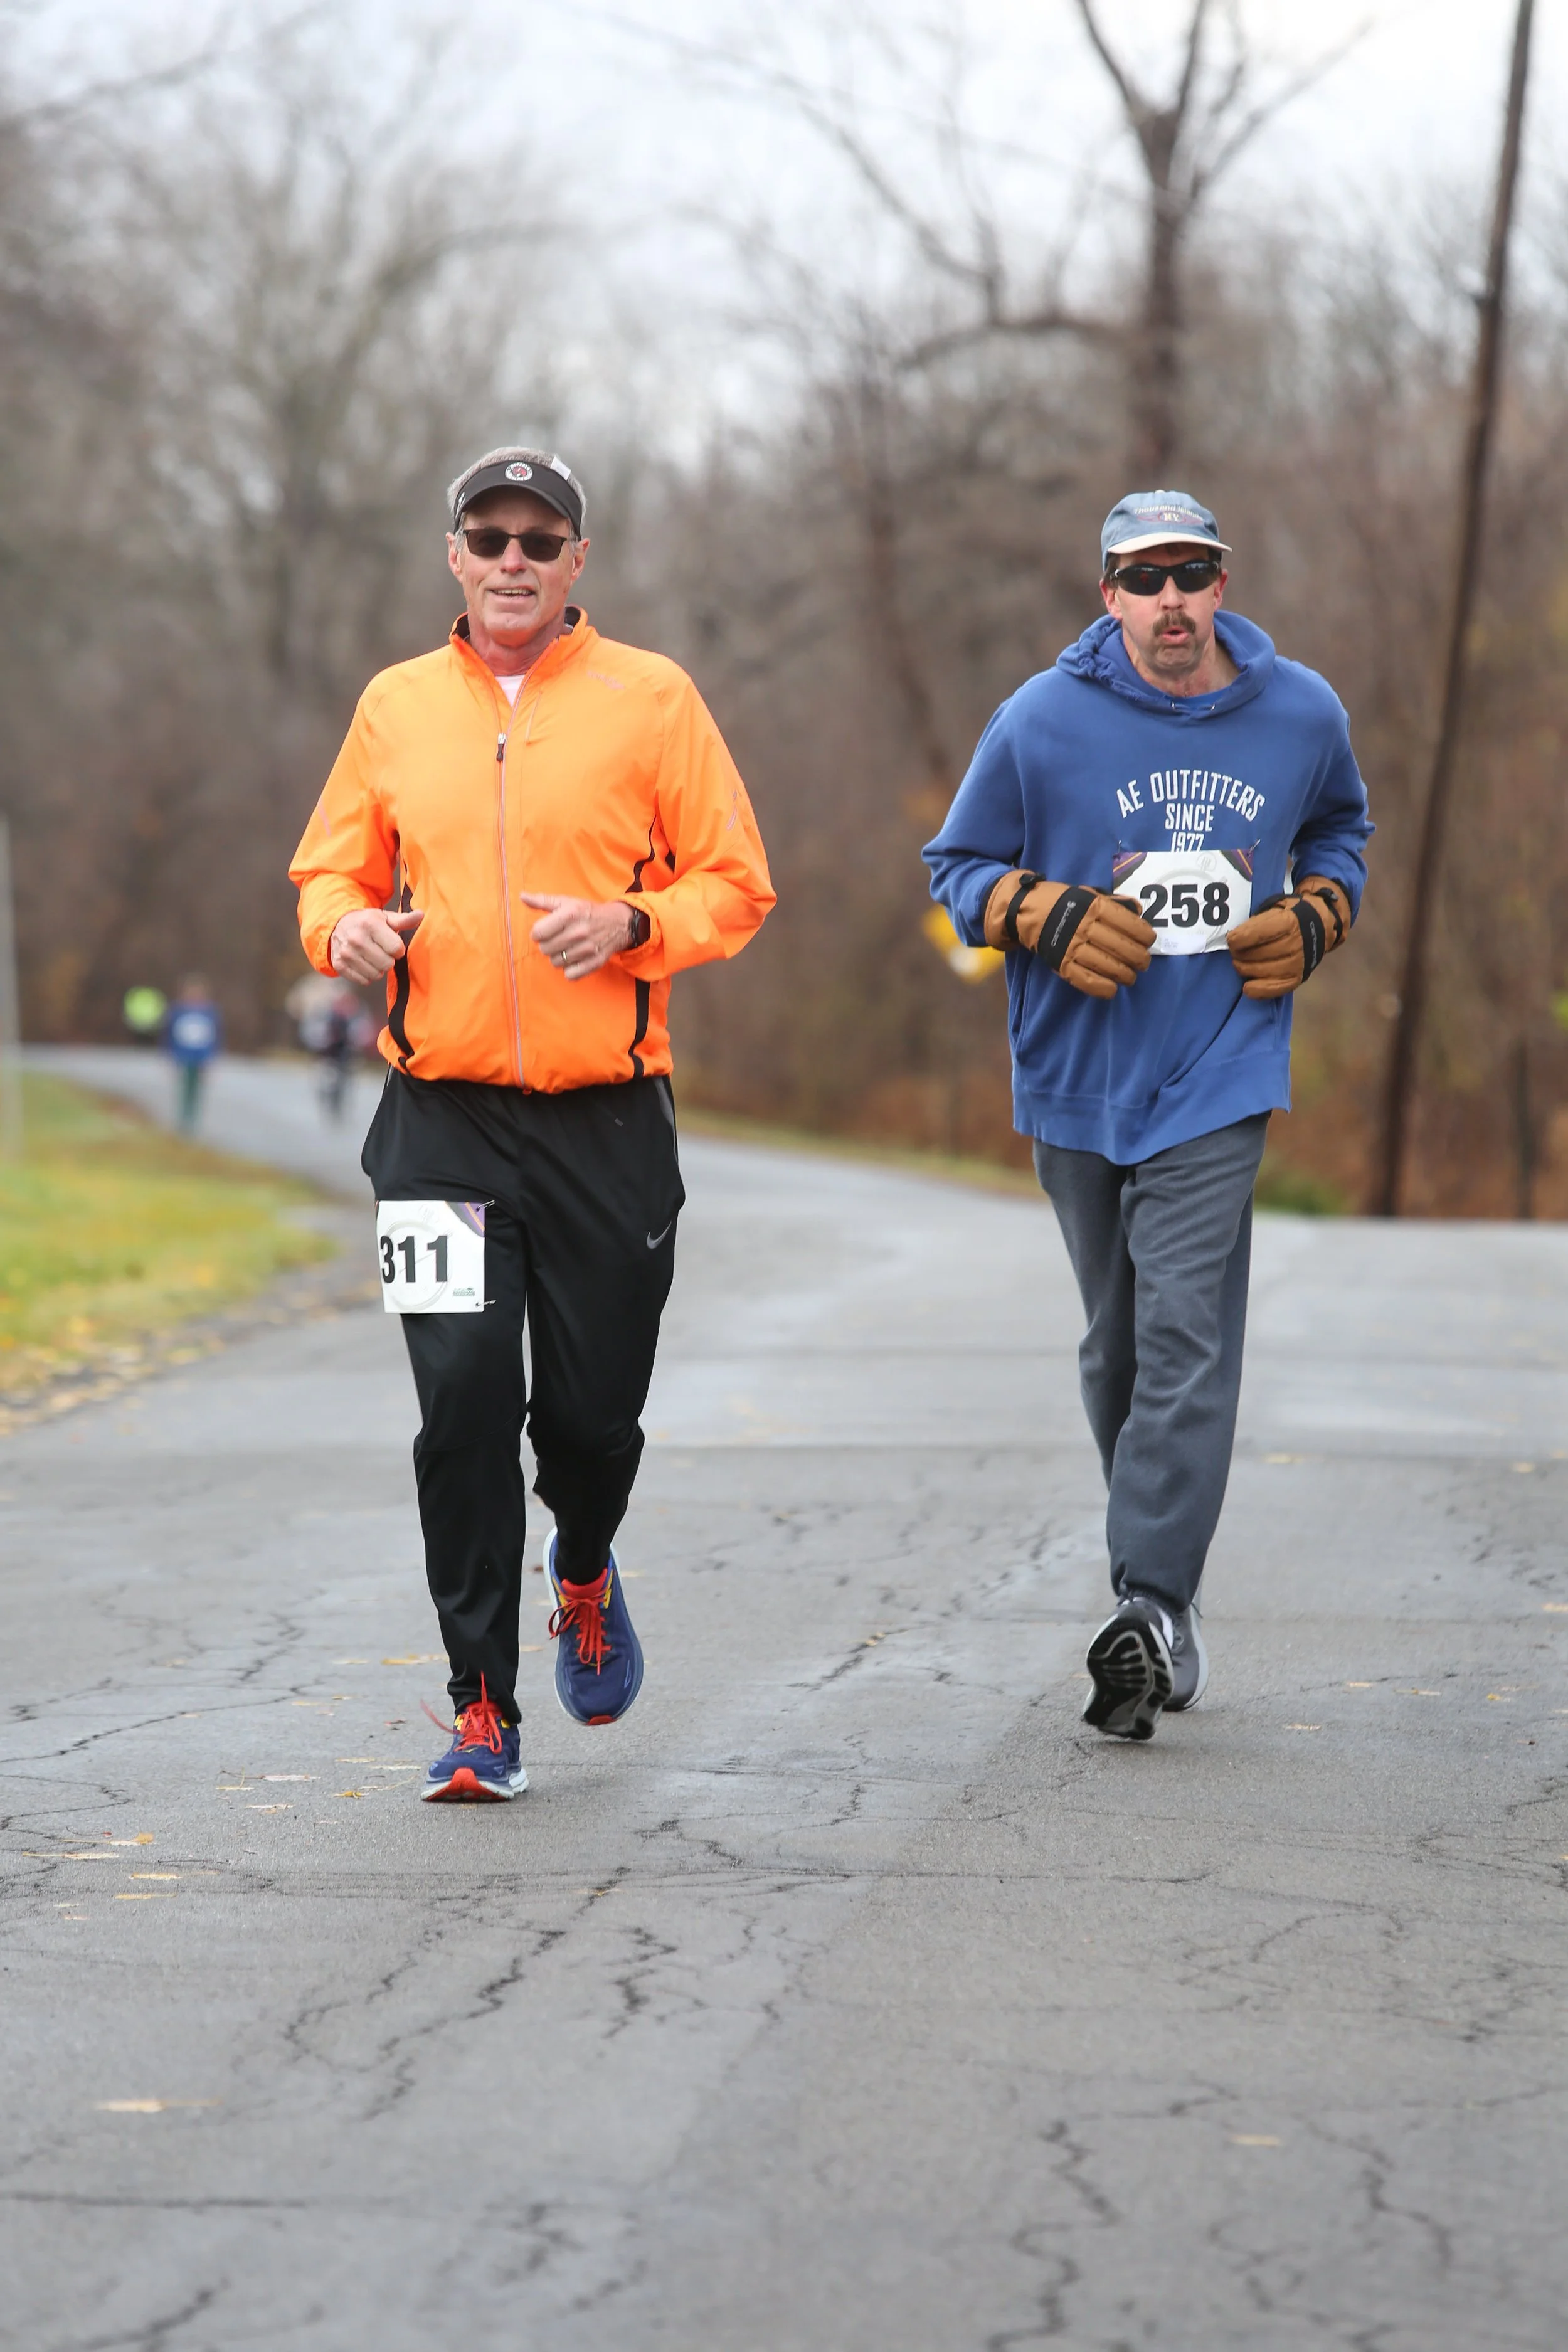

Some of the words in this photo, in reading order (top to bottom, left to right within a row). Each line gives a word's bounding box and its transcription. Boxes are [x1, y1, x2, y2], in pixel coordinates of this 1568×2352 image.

[1163, 512, 1180, 522] NY
[1116, 780, 1144, 818] AE
[1150, 769, 1266, 822] OUTFITTERS
[1165, 803, 1215, 832] SINCE
[1171, 832, 1204, 853] 1977
[1140, 882, 1230, 928] 258
[380, 1235, 448, 1283] 311
